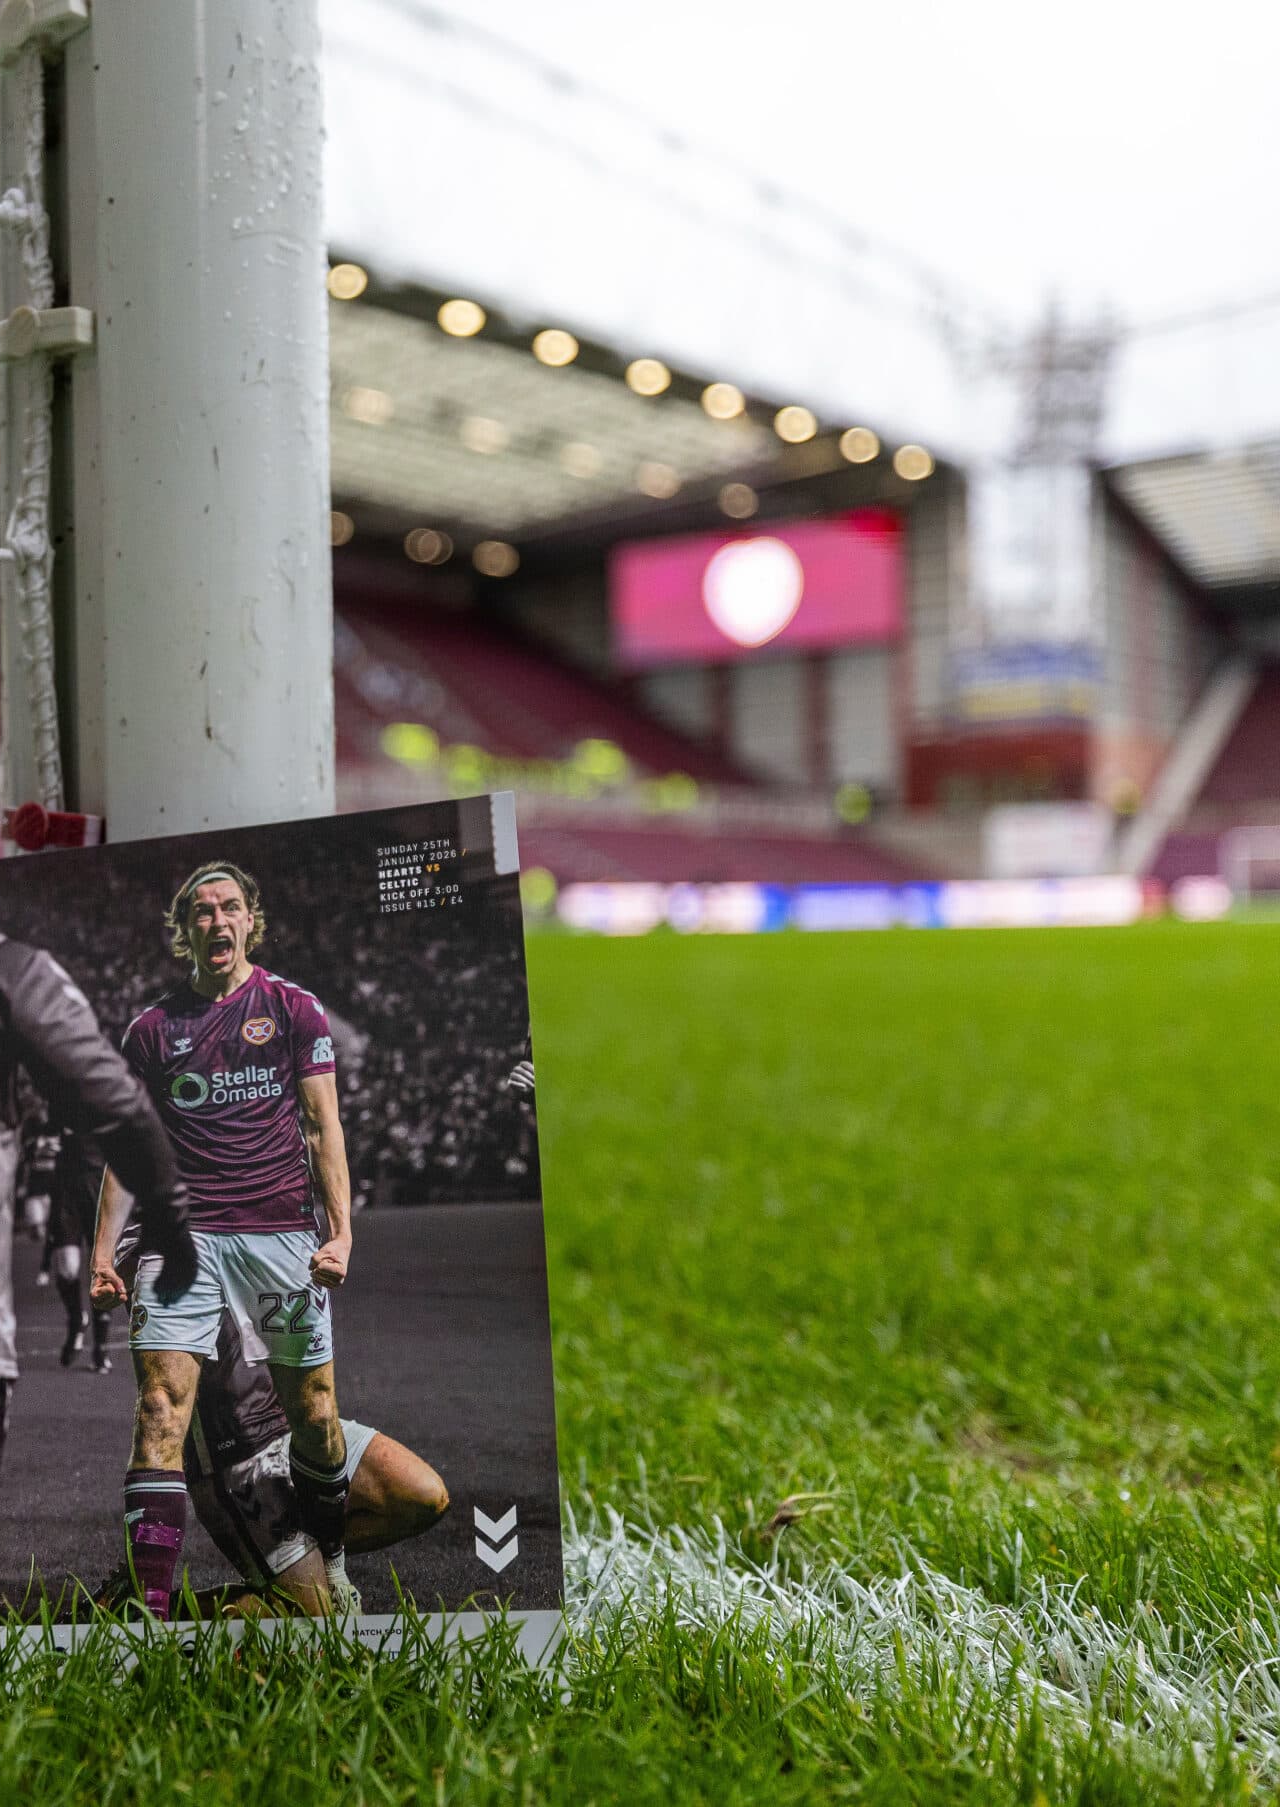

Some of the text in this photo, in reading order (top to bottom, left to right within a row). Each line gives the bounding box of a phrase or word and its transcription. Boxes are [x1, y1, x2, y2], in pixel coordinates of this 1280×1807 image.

[377, 839, 450, 856] SUNDAY 25TH
[378, 854, 425, 868] JANUARY
[430, 849, 457, 861] 2026
[378, 863, 441, 879] HEARTS VS
[379, 878, 419, 890] CELTIC
[380, 884, 459, 902] KICK OFF 3:00
[380, 901, 412, 913] ISSUE
[416, 899, 436, 909] #15
[451, 895, 463, 905] £4
[211, 1065, 277, 1089] Stellar
[212, 1081, 282, 1104] Omada
[259, 1290, 314, 1333] 22
[352, 1628, 382, 1636] MATCH
